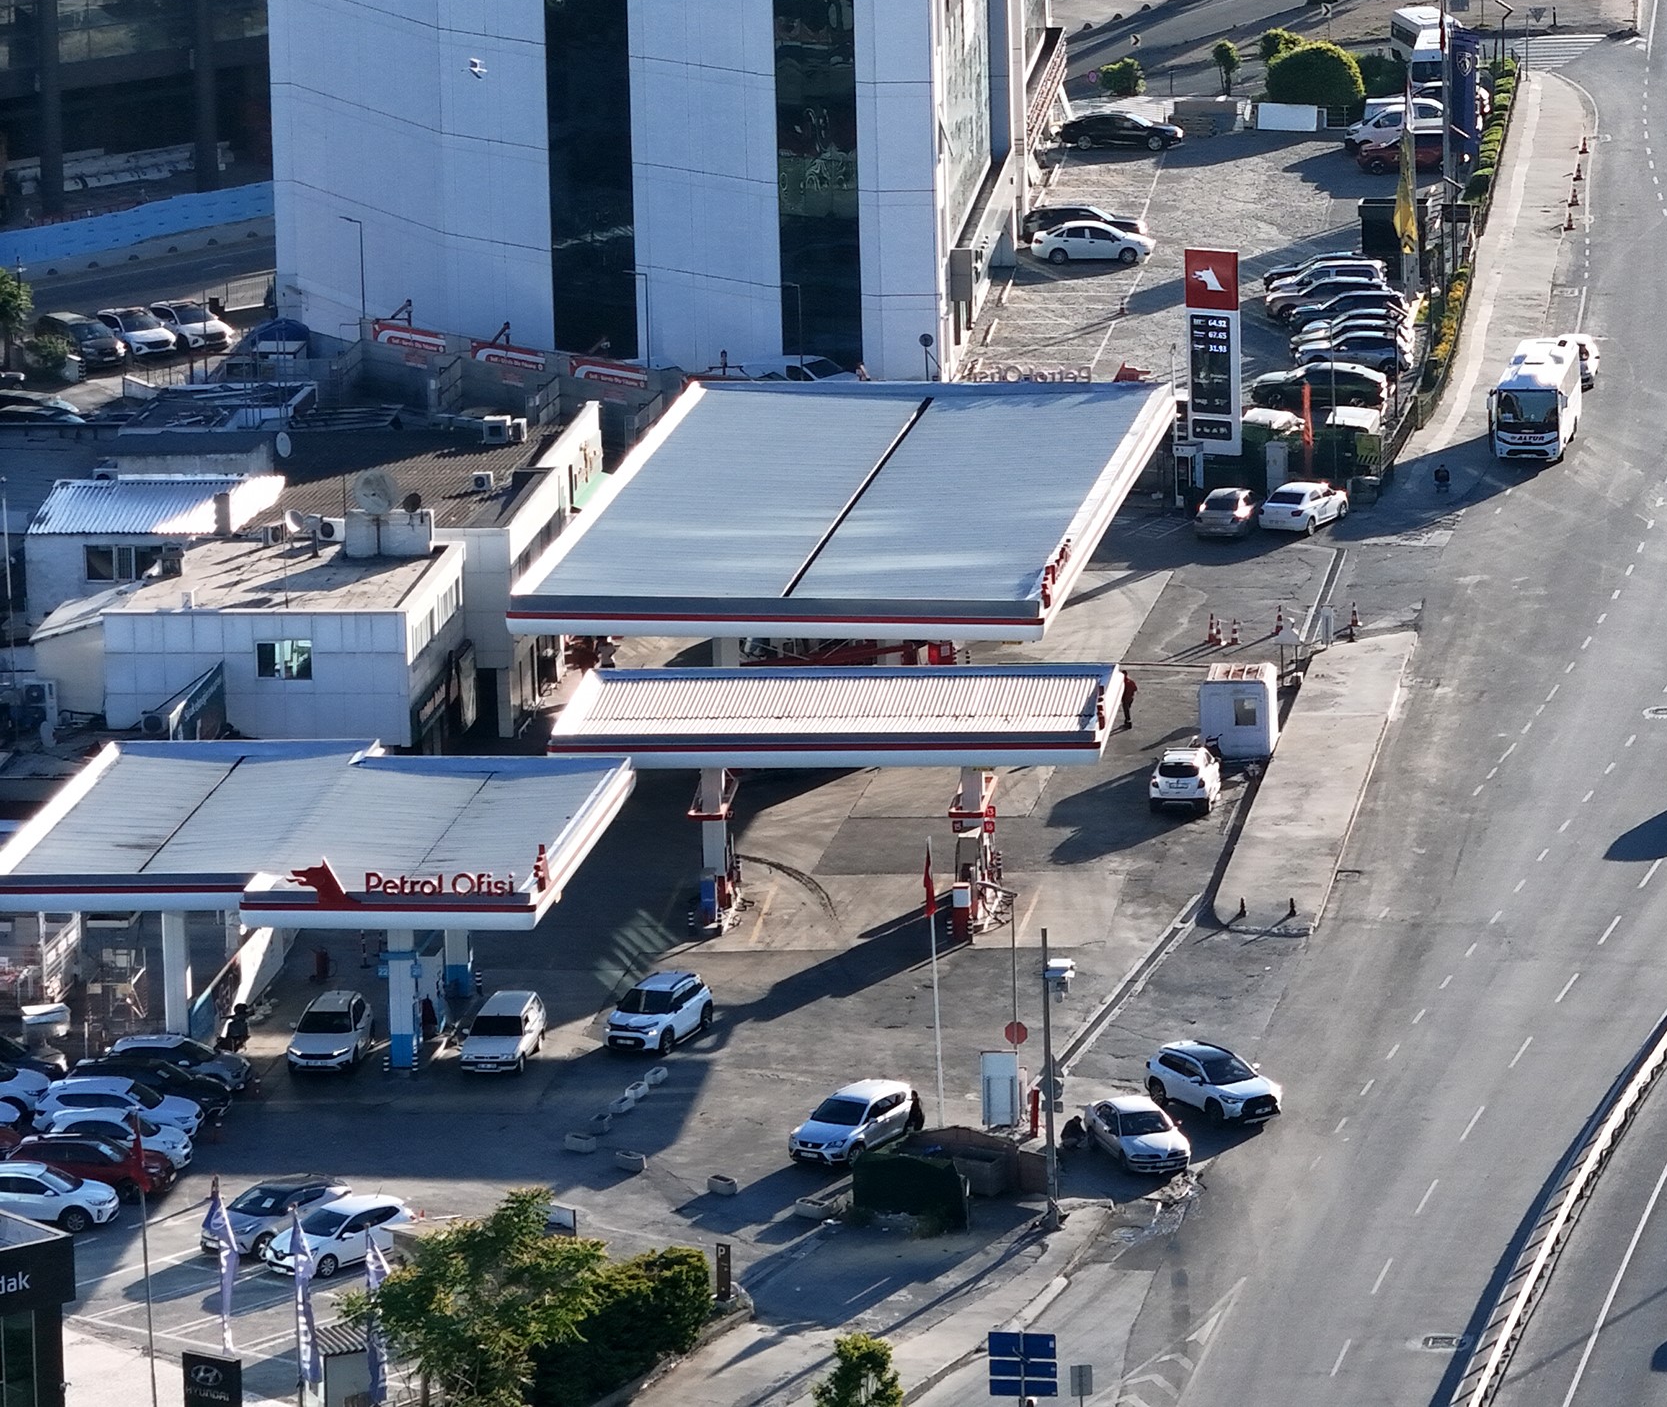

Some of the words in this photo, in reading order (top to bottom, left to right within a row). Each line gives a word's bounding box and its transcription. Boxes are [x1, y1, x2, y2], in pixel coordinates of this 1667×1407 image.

[365, 871, 444, 897] Petrol
[451, 871, 516, 897] Ofisi
[717, 1246, 726, 1259] P
[185, 1386, 230, 1402] HYUNDAI
